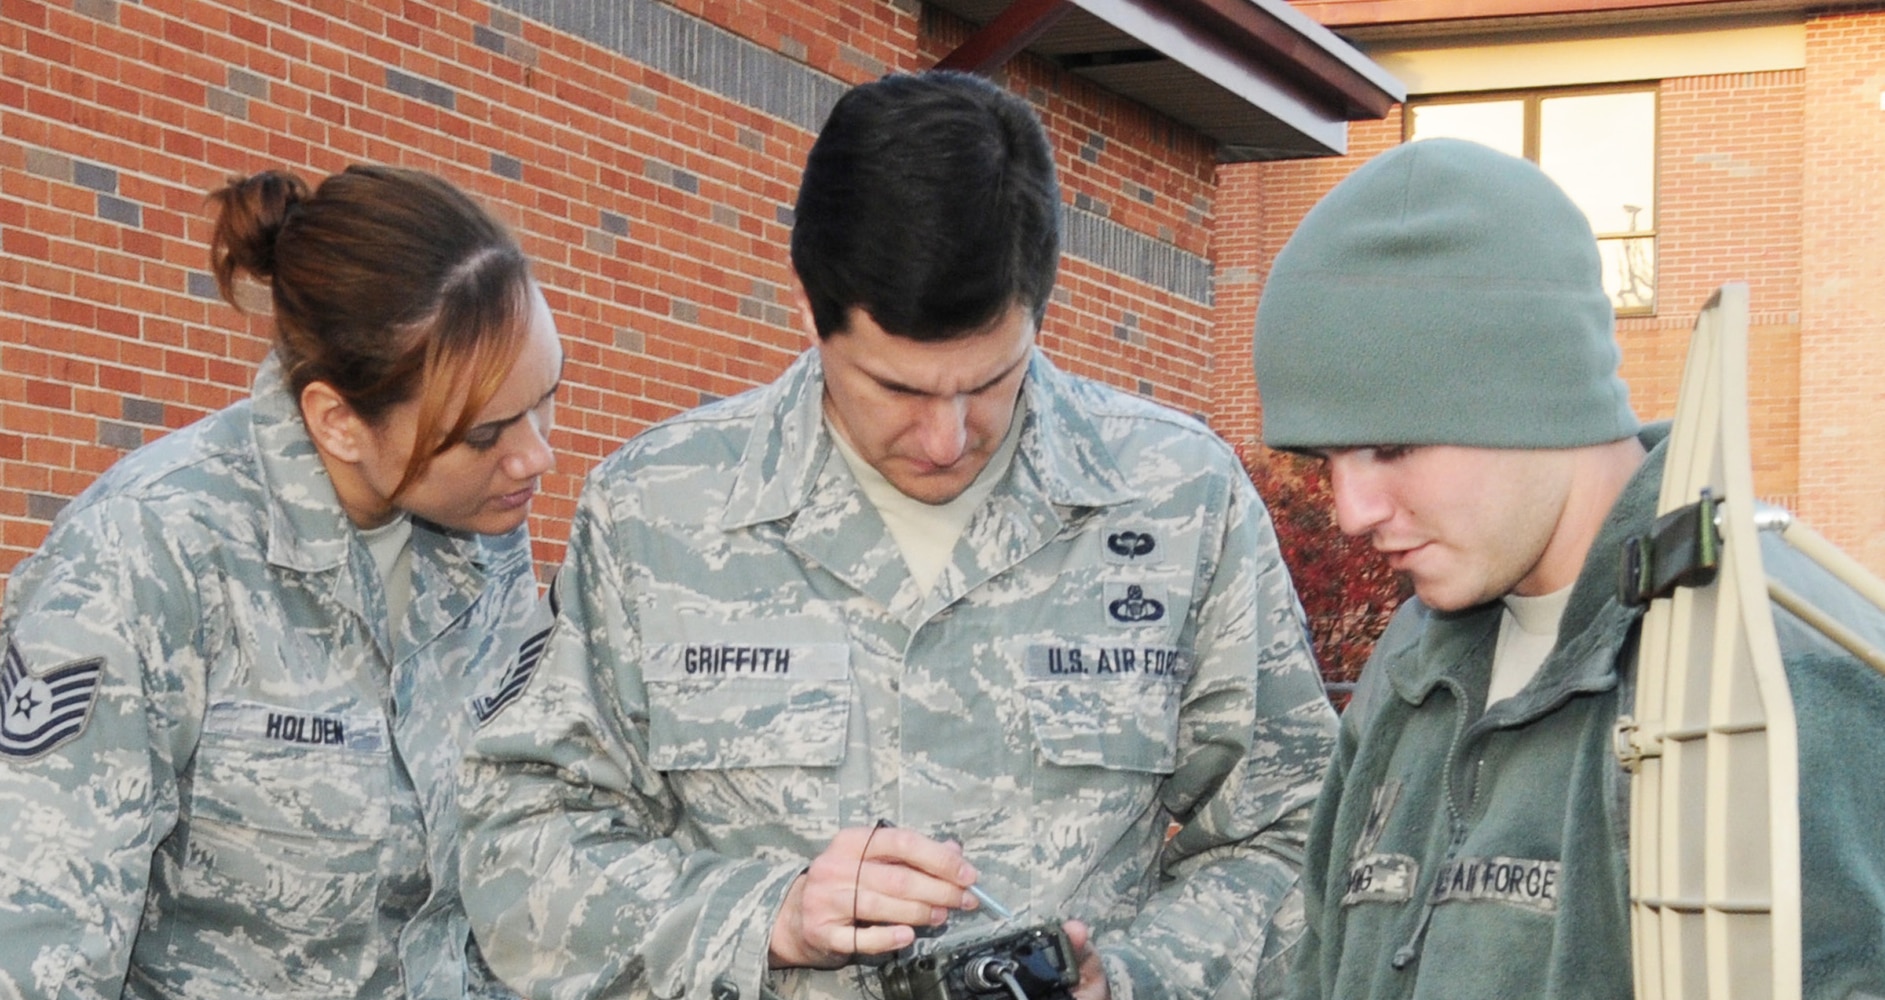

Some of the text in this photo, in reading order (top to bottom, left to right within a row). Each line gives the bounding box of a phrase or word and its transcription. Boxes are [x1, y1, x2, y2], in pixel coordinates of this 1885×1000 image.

[685, 646, 790, 674] GRIFFITH
[1048, 647, 1089, 675] U.S.
[1097, 647, 1136, 674] AIR
[266, 712, 344, 745] HOLDEN
[1482, 862, 1557, 899] FORCE
